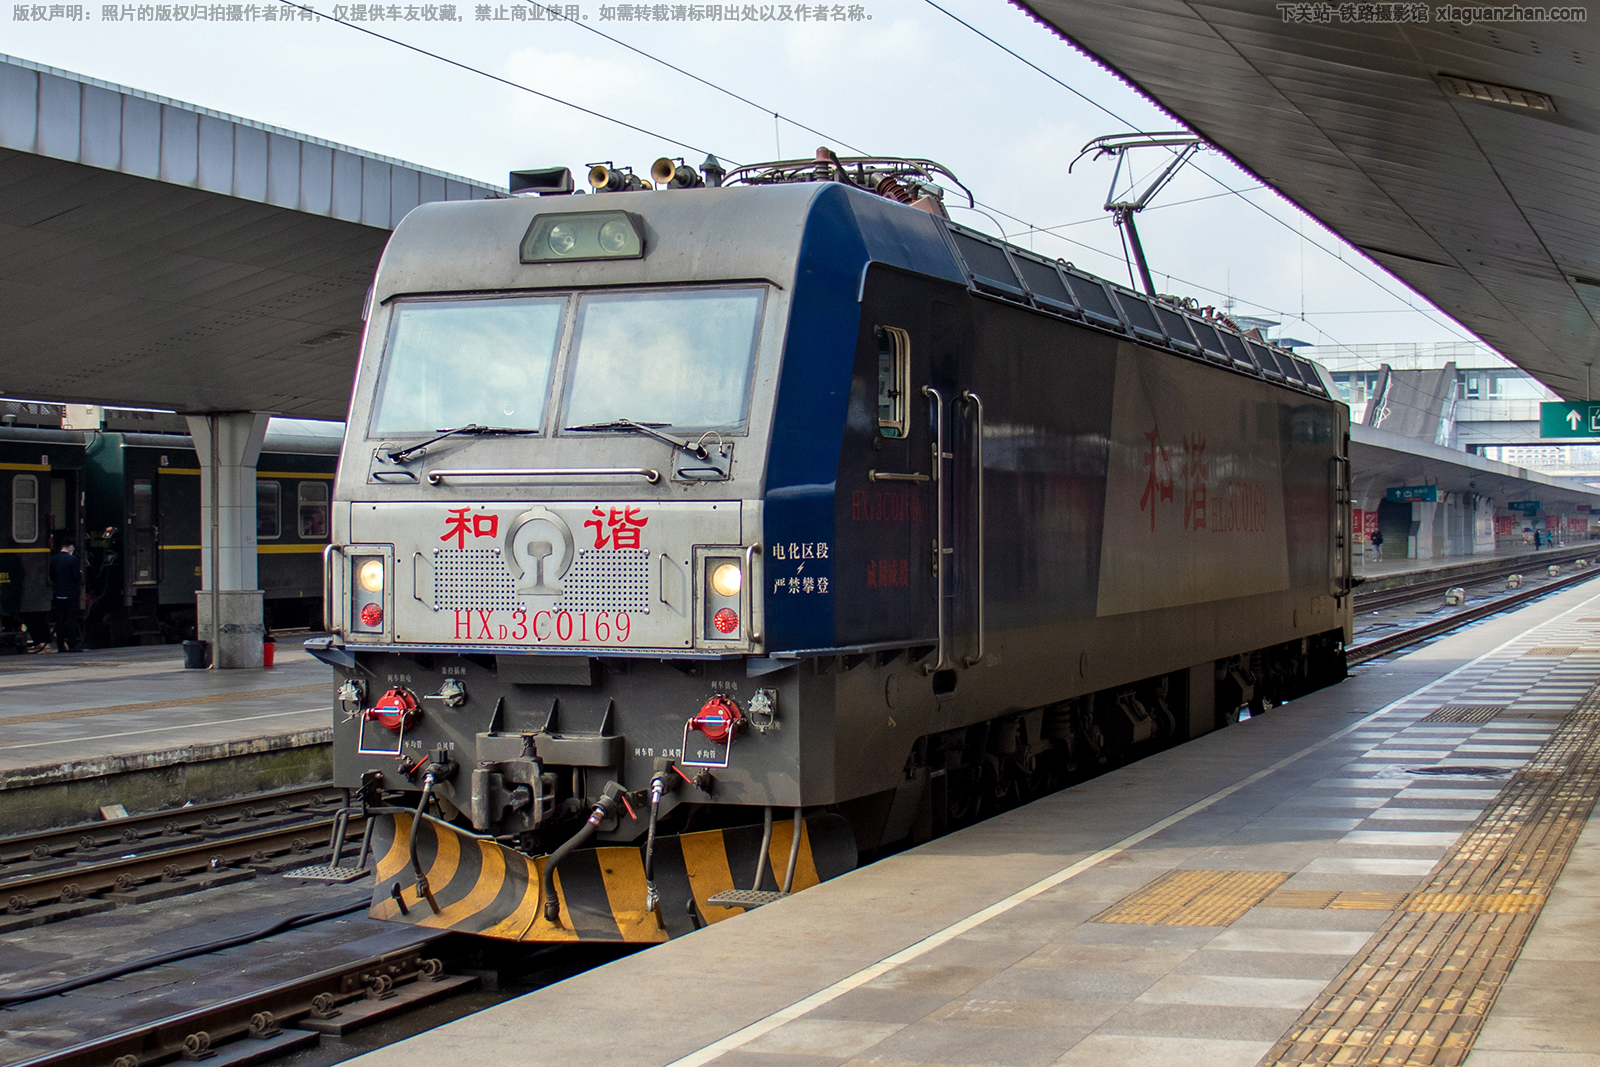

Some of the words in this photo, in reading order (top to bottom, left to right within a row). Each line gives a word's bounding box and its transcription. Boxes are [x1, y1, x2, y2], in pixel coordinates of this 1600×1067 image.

[1140, 424, 1209, 533] 和谐
[440, 505, 498, 550] 和
[583, 505, 649, 550] 谐
[772, 542, 829, 560] 电化区段
[773, 577, 829, 594] 严禁攀登
[454, 609, 631, 642] HXD3C0169
[661, 748, 682, 758] 总风管
[696, 749, 717, 759] 平均管
